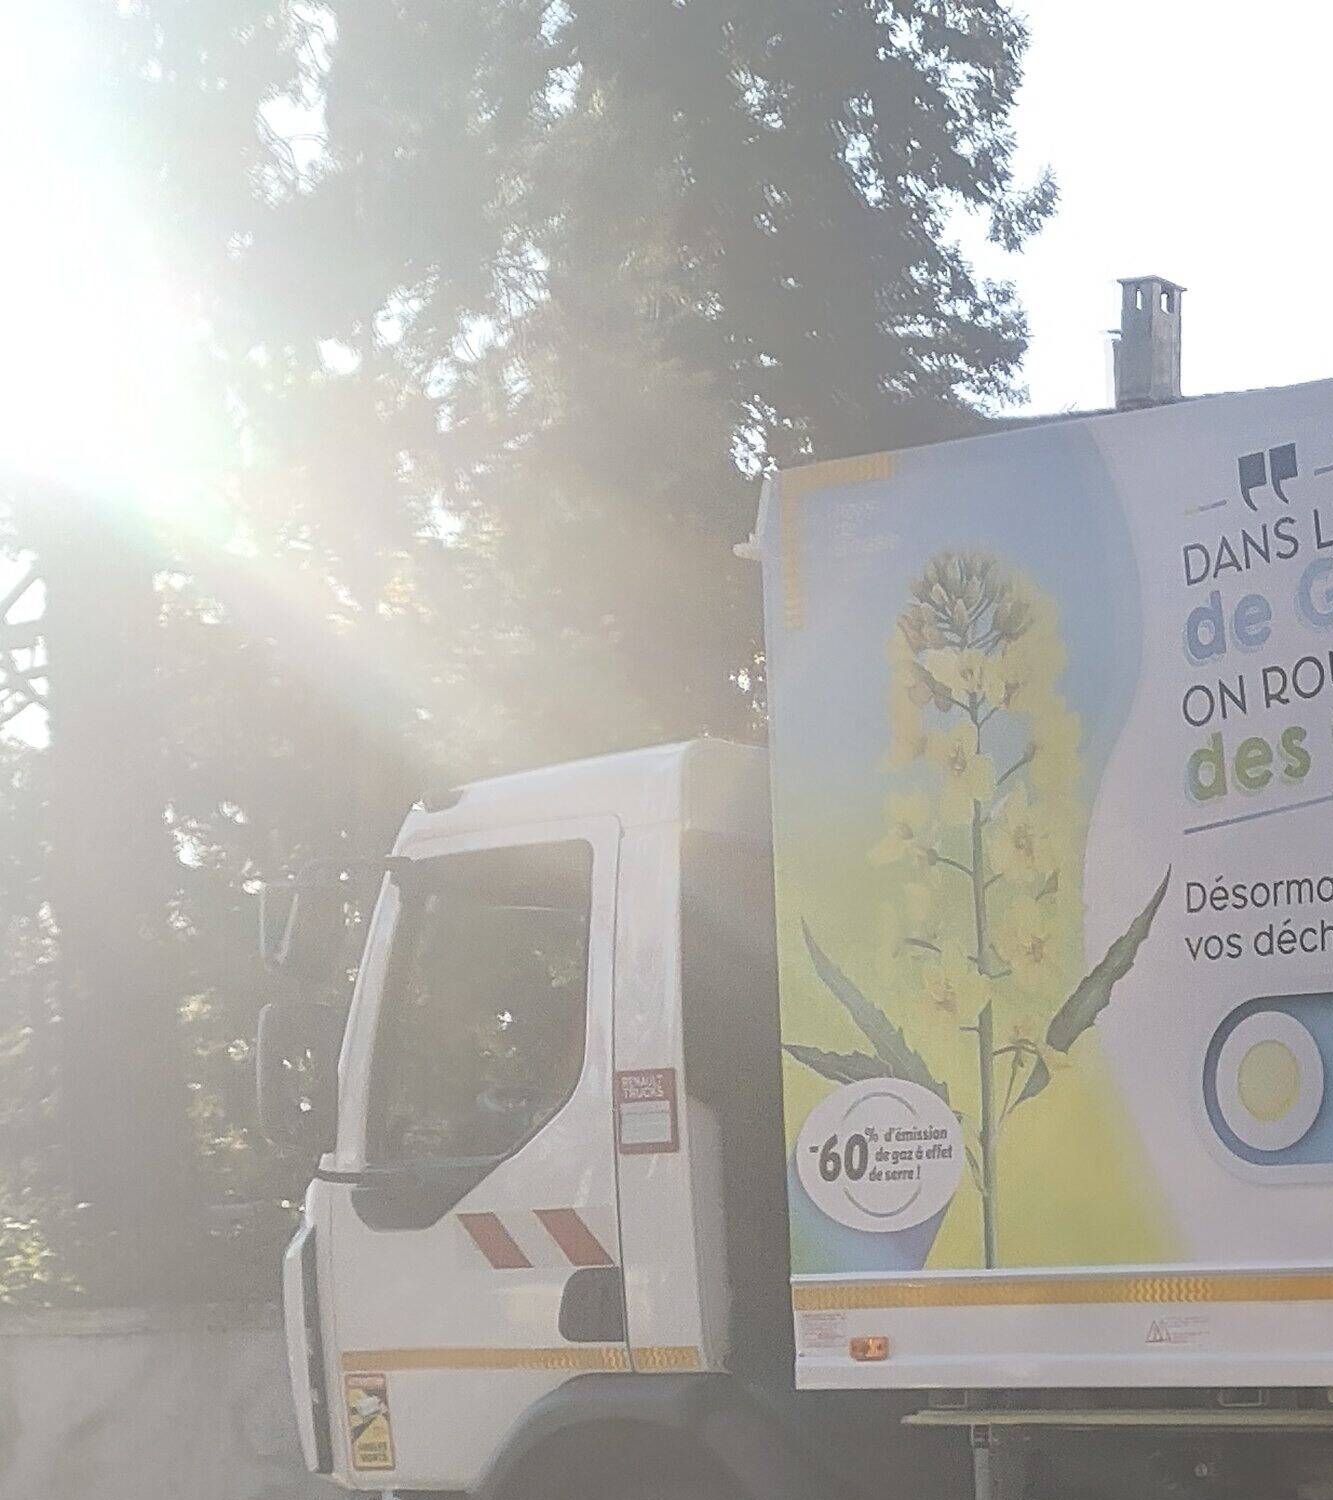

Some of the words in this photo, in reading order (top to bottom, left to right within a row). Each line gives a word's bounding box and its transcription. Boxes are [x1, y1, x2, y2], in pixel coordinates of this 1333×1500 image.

[1182, 516, 1301, 586] DANS
[1184, 590, 1272, 666] de
[1182, 674, 1247, 726] ON
[1185, 725, 1312, 801] des
[1184, 933, 1243, 962] vos
